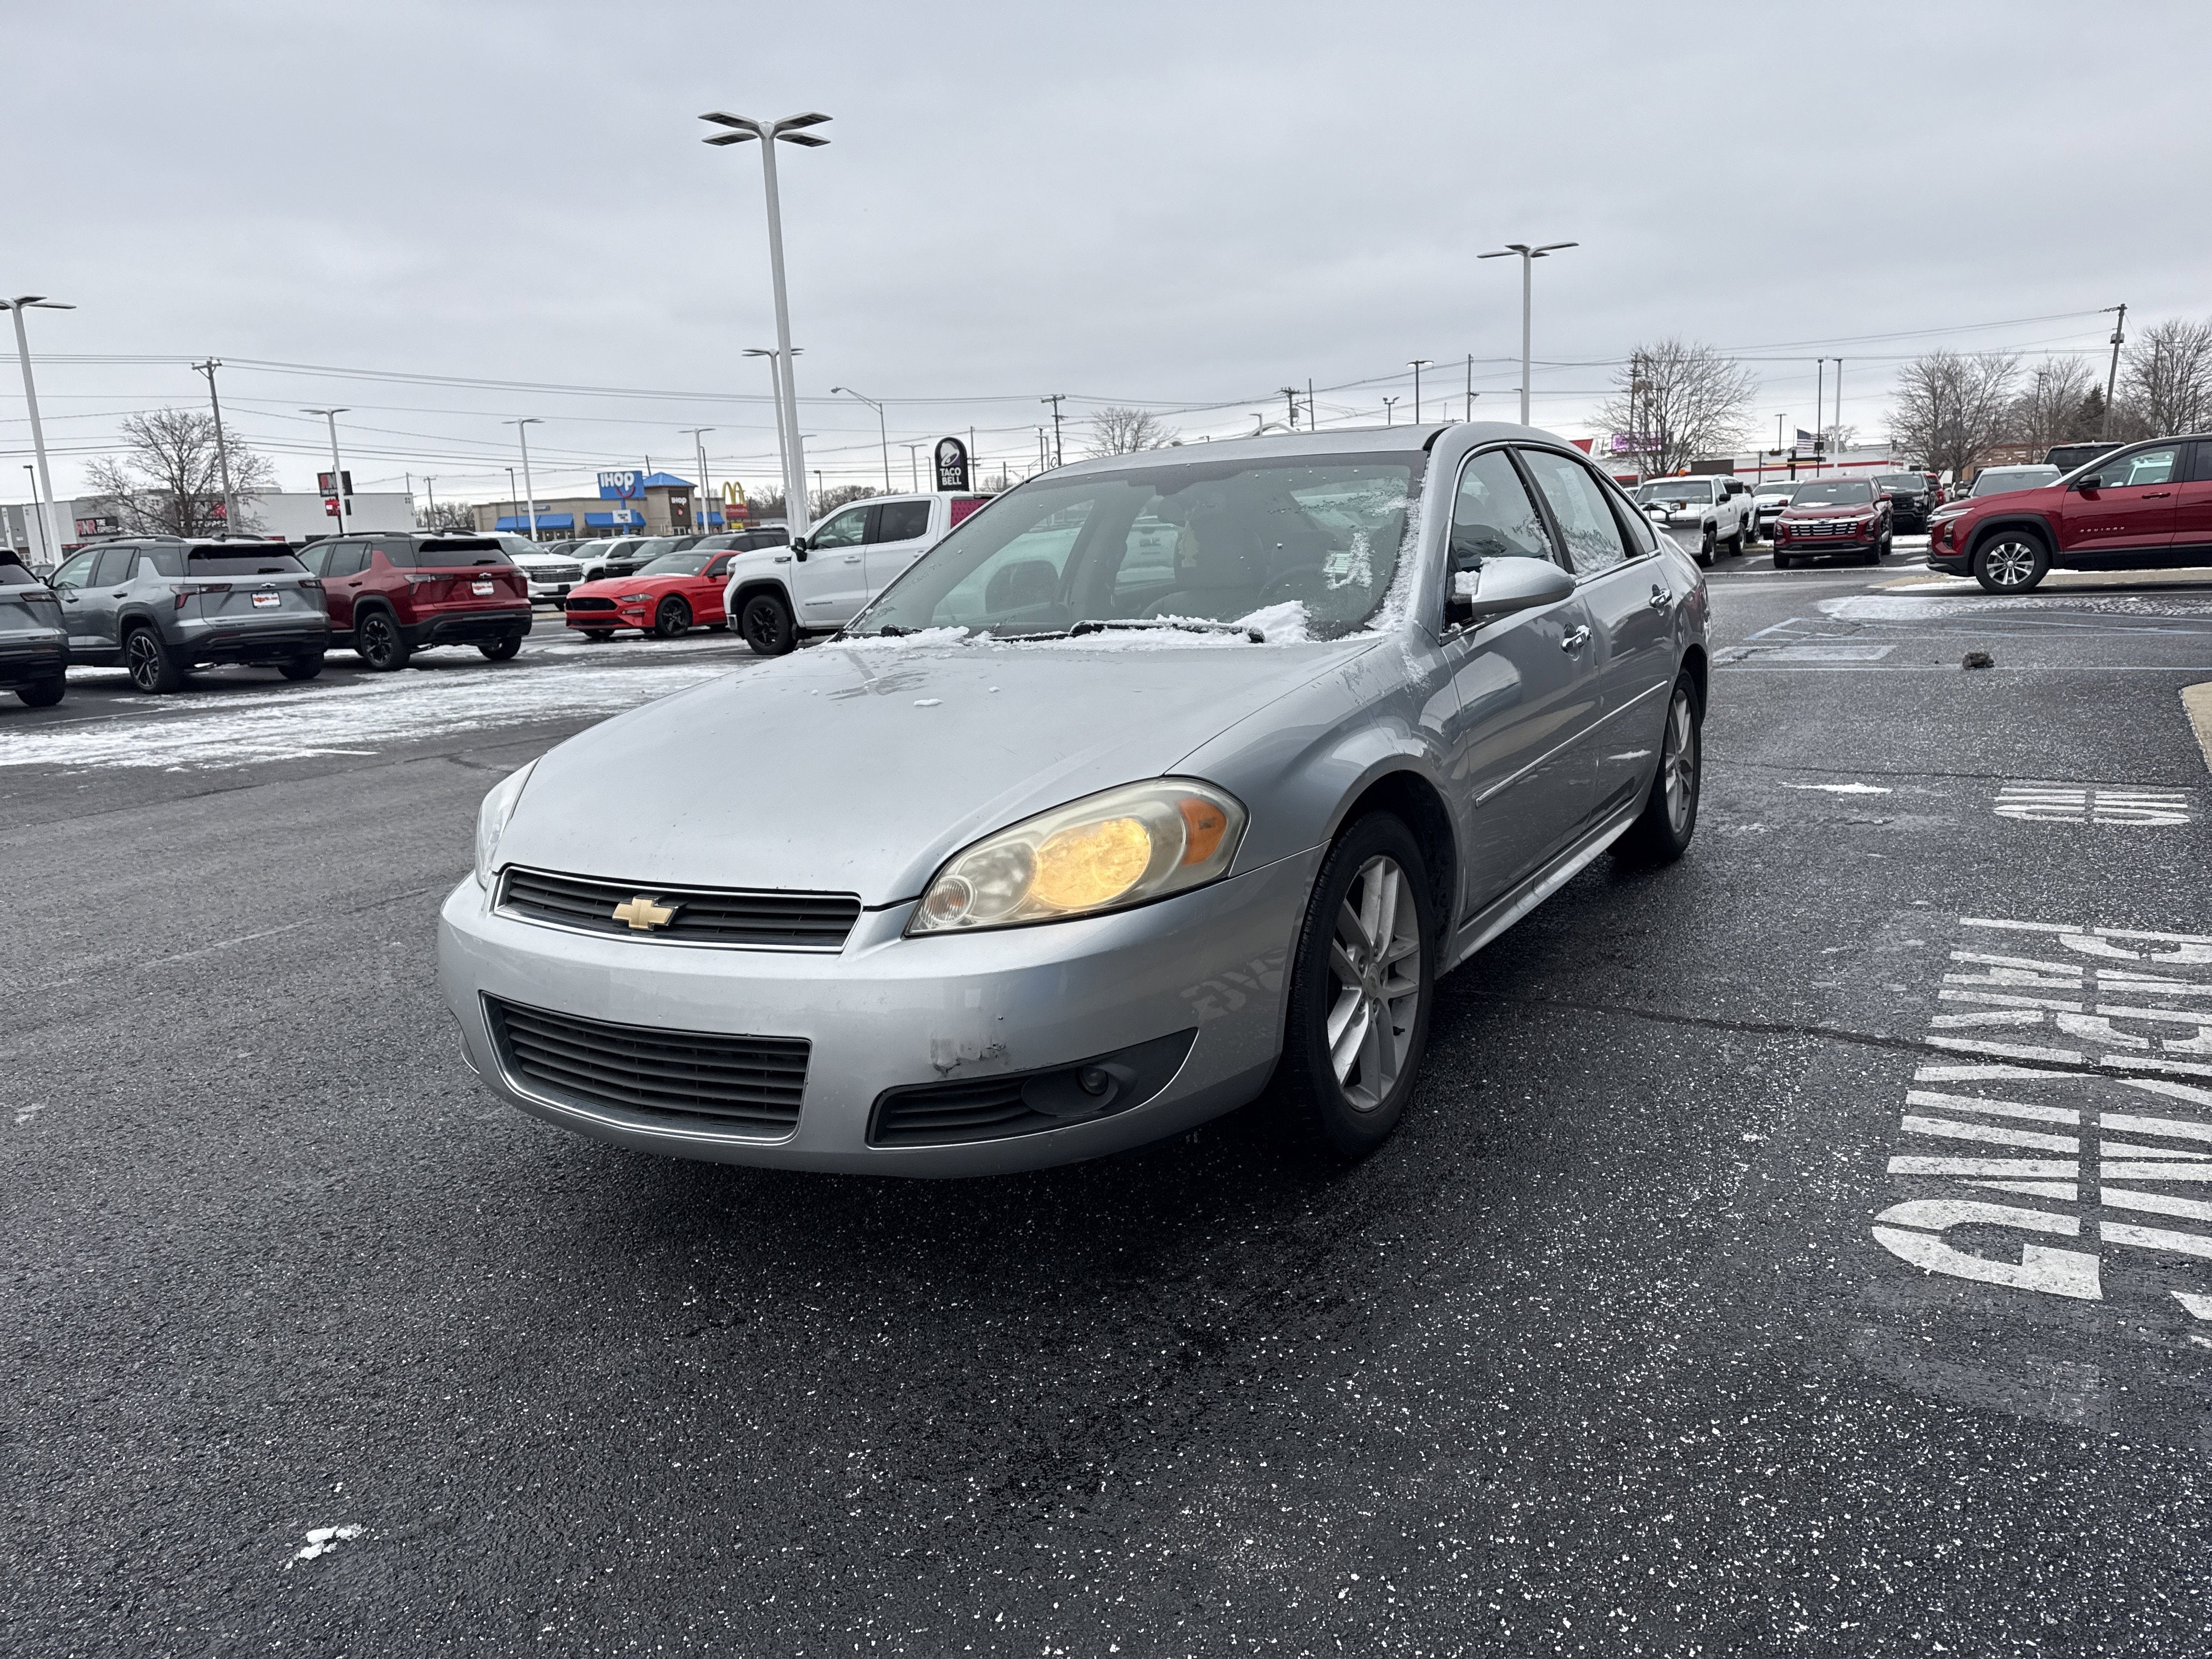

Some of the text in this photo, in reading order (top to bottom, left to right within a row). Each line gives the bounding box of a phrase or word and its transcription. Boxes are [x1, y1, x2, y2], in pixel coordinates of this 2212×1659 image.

[939, 467, 961, 476] TACO
[600, 472, 635, 491] IHOP
[941, 476, 962, 486] BELL
[76, 520, 97, 535] RNR
